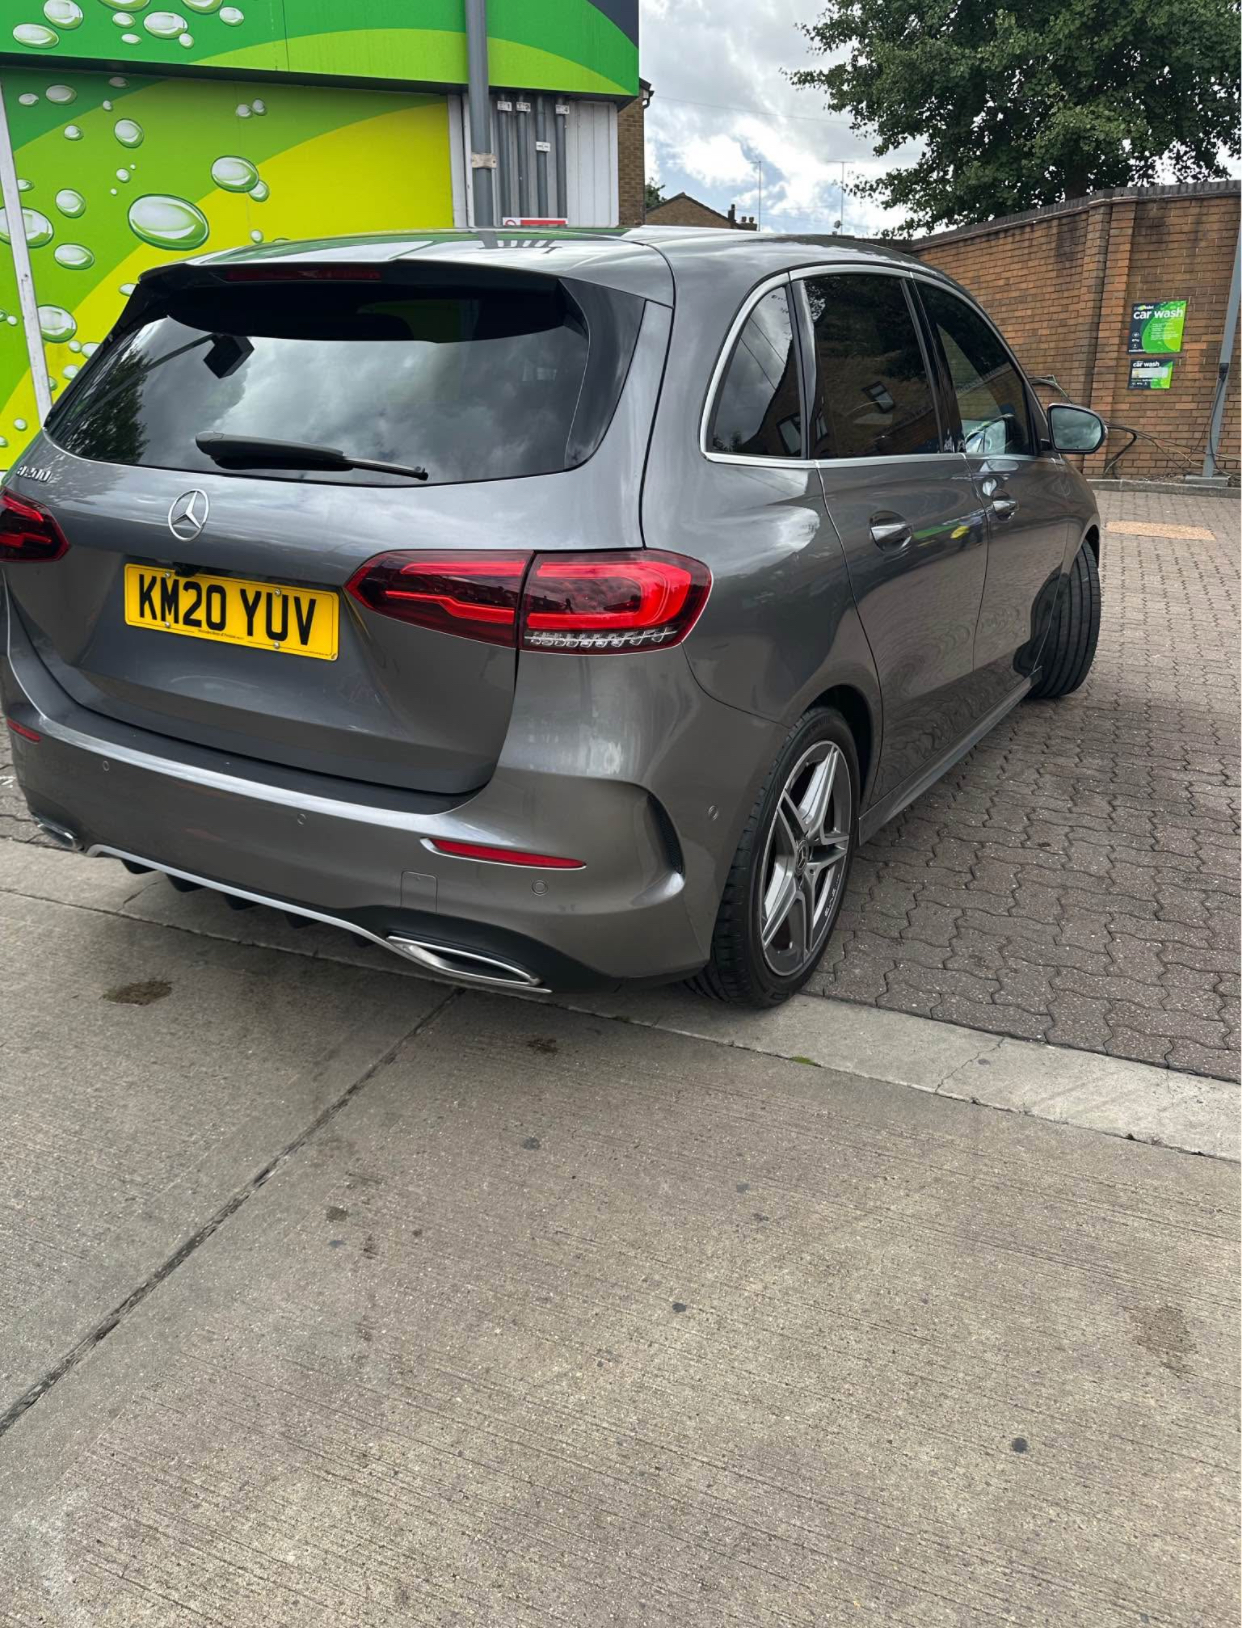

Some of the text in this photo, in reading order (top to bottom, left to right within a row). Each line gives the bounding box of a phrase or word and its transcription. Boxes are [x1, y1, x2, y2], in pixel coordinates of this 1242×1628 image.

[1133, 310, 1151, 319] car
[1154, 307, 1183, 318] wash
[139, 574, 317, 646] KM20 YUV
